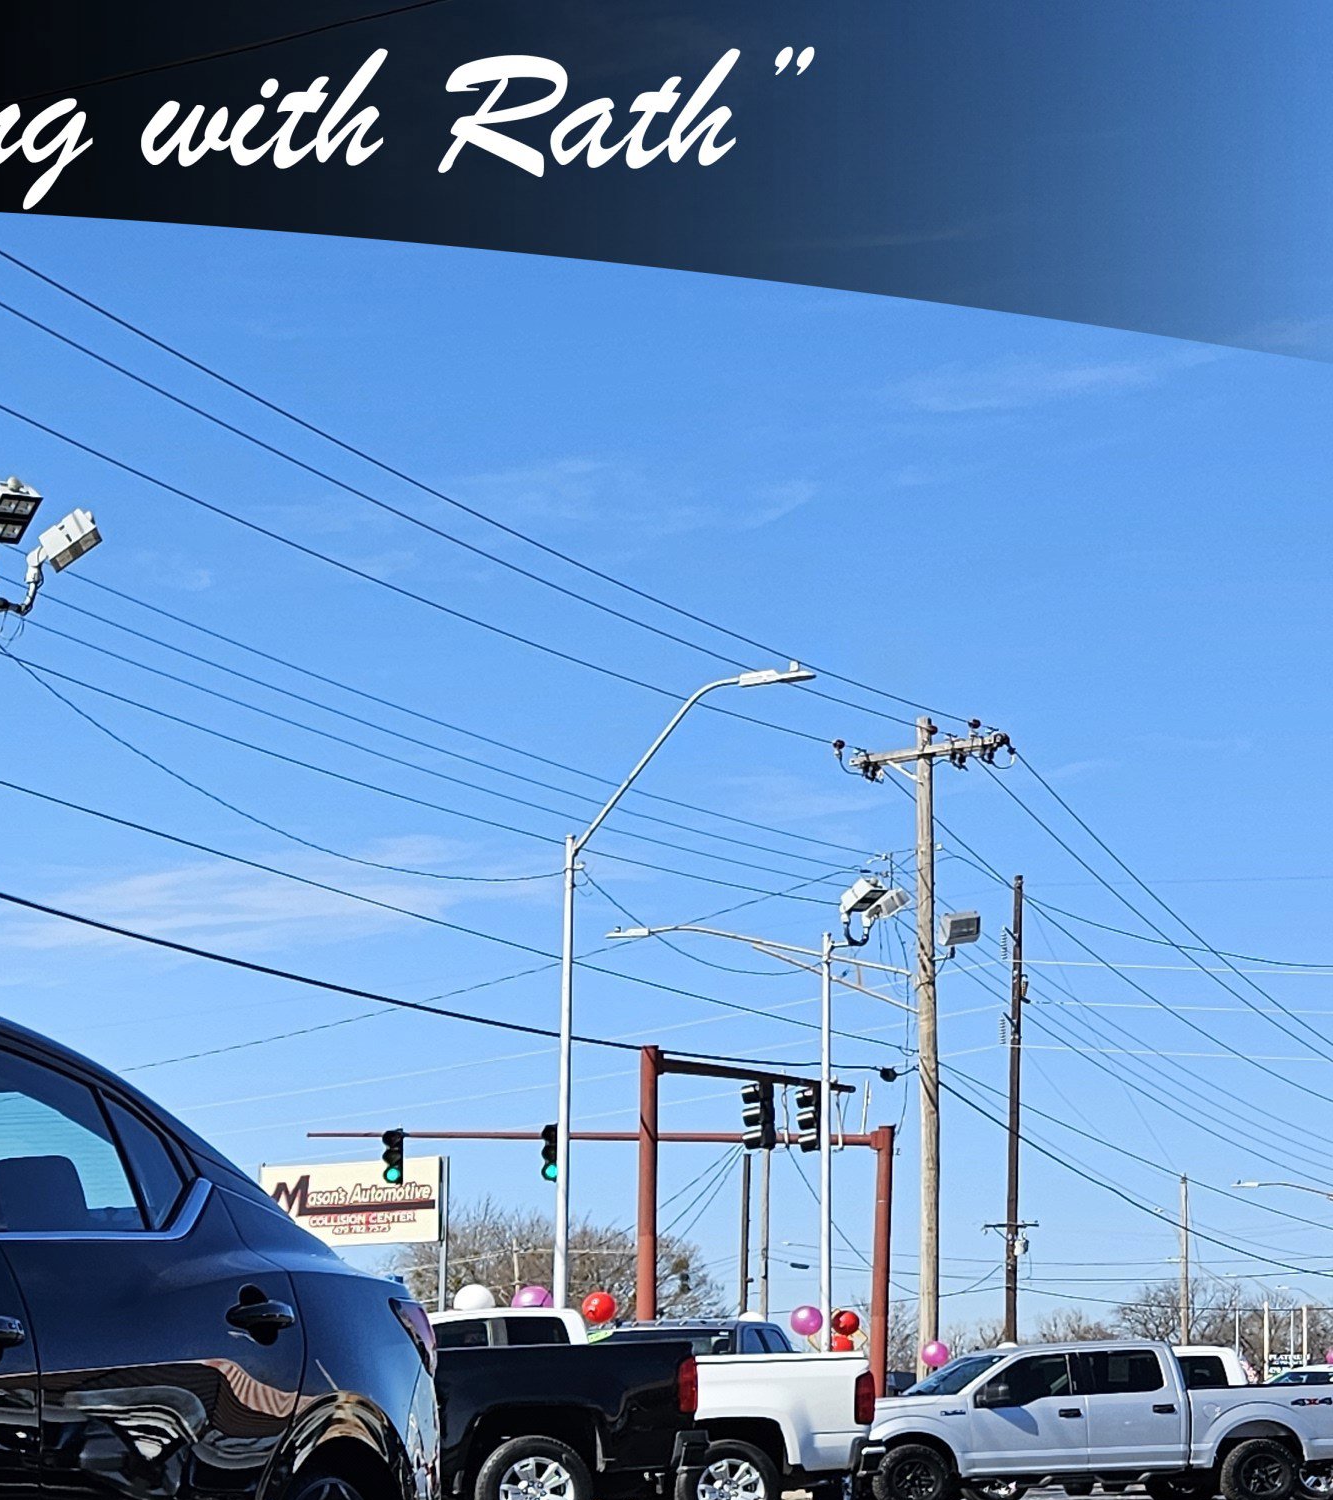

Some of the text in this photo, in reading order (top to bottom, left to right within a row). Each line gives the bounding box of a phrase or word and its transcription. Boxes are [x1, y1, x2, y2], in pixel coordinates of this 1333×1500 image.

[271, 1175, 433, 1216] Mason's Automotive
[309, 1210, 416, 1227] COLLISION CENTER
